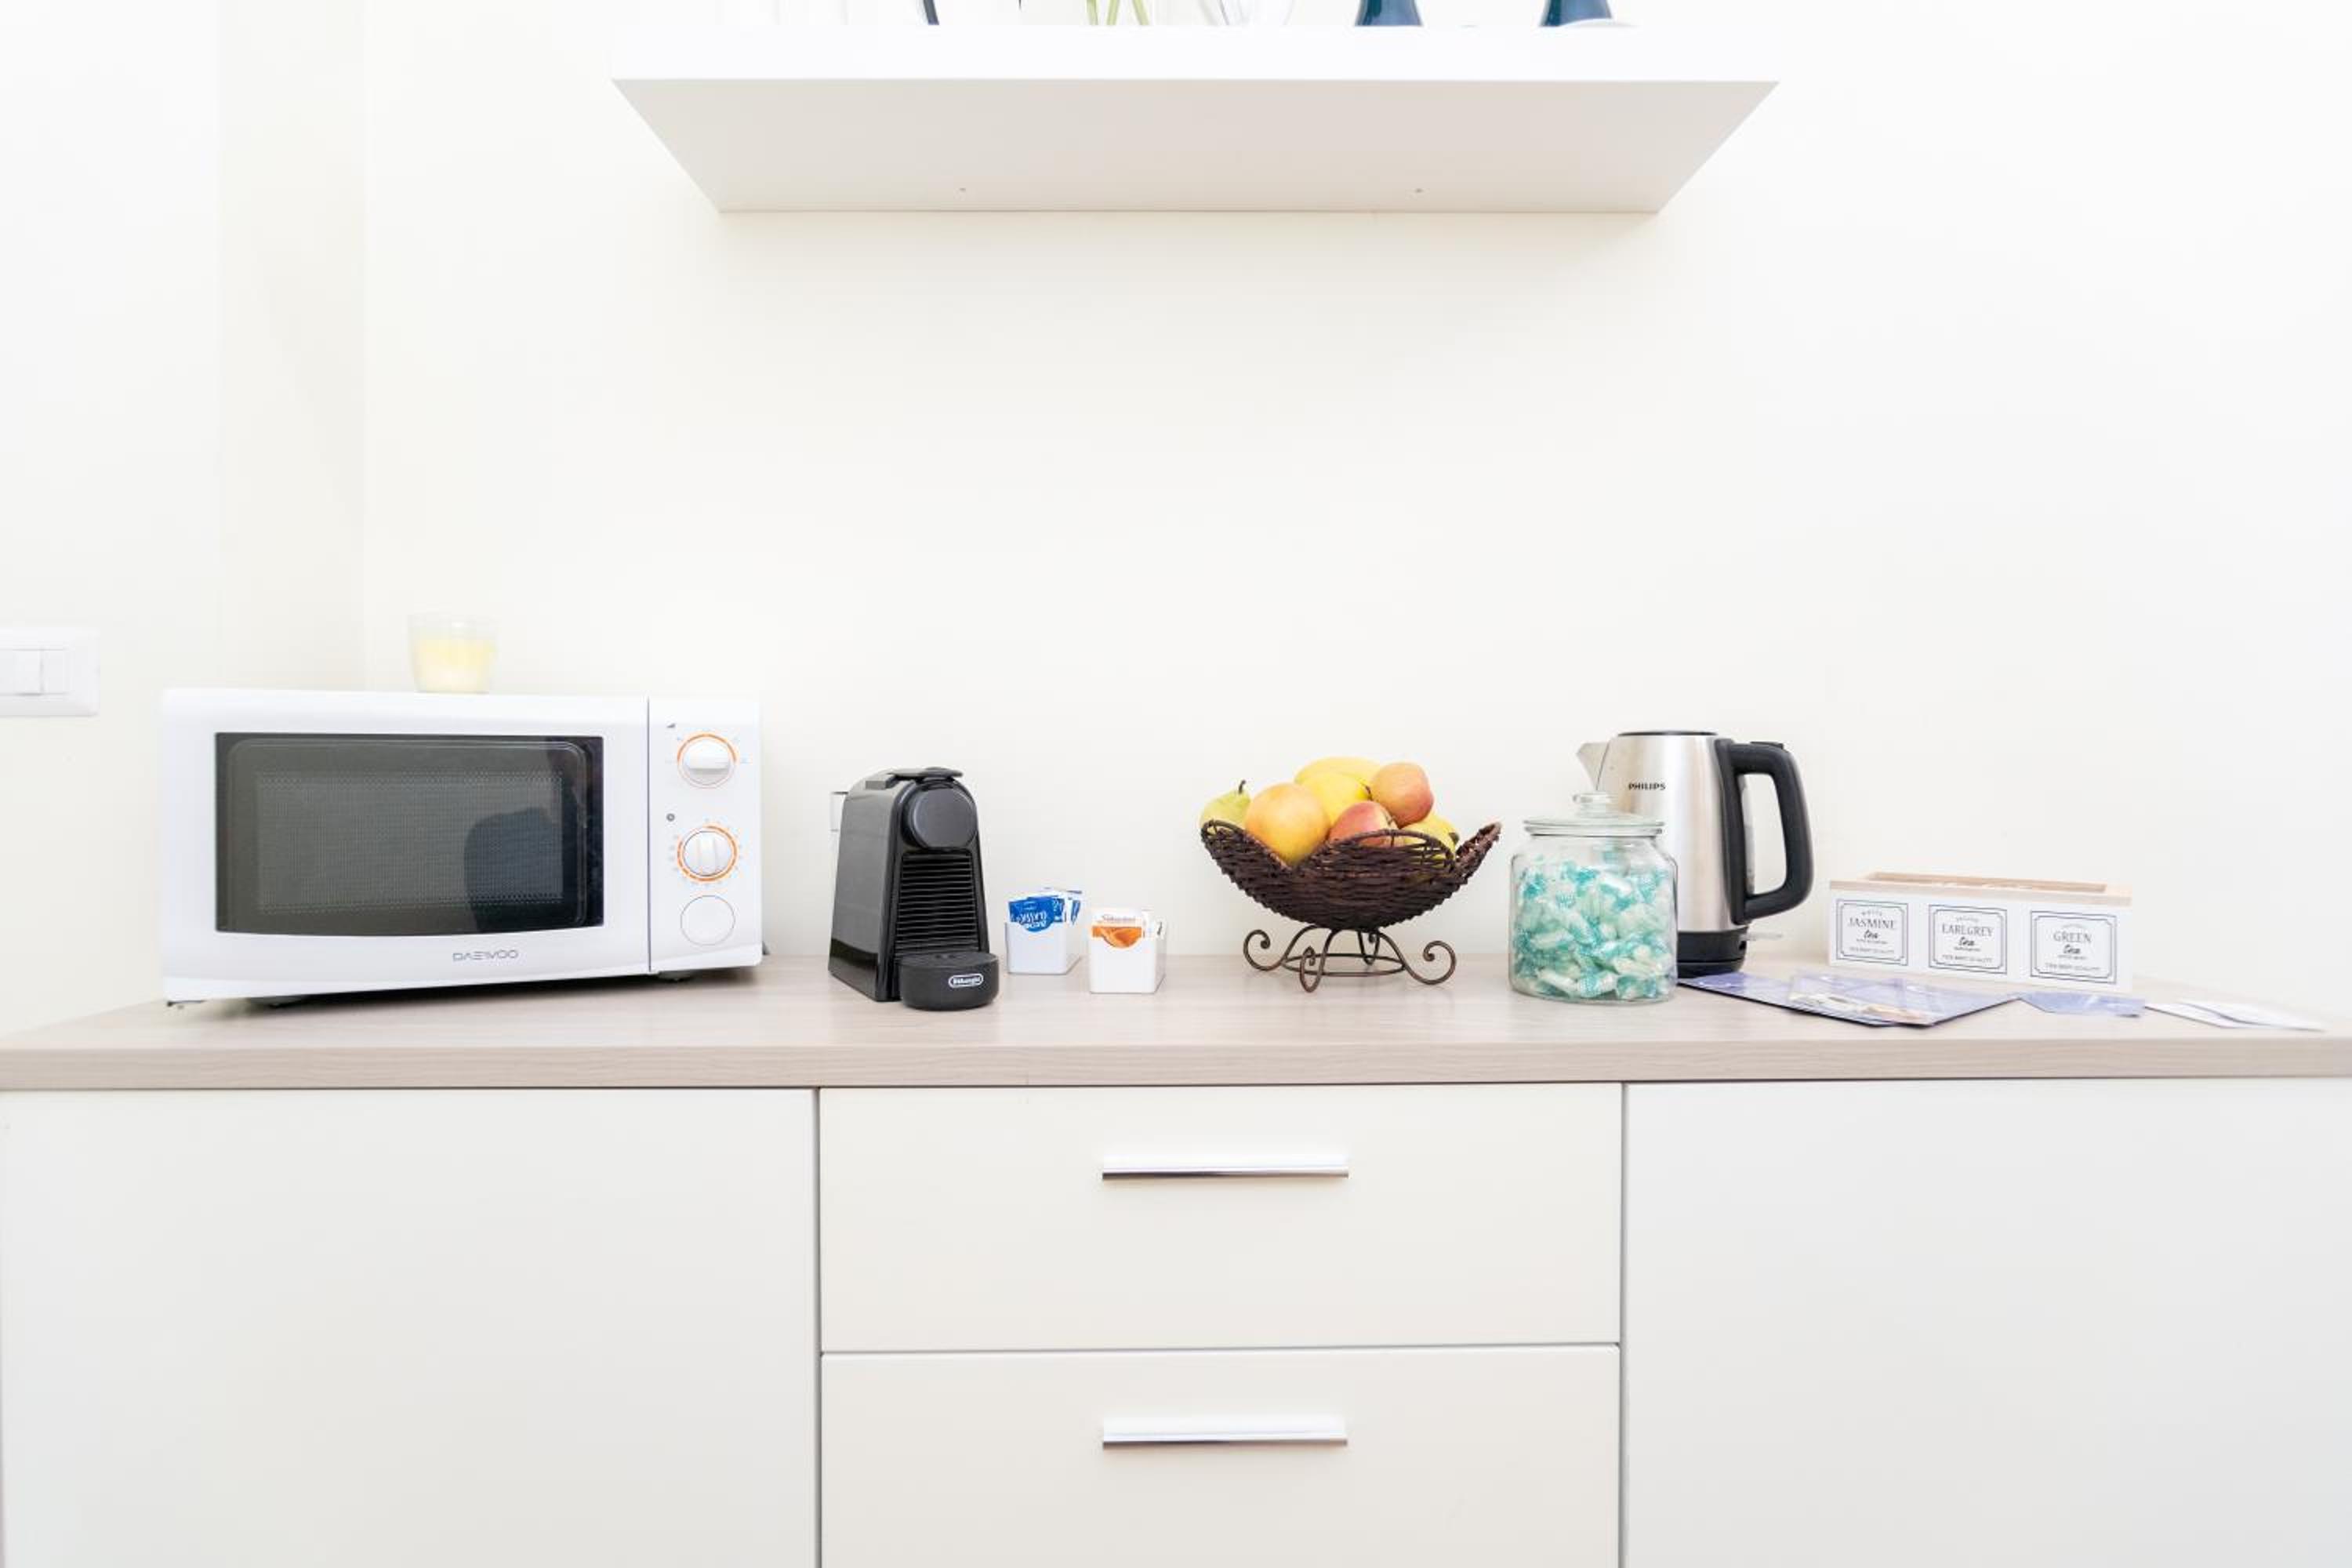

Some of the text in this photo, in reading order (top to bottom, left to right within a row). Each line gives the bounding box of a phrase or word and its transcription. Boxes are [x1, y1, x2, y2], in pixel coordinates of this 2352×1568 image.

[1847, 917, 1896, 930] JASMINE
[1864, 929, 1879, 939] tea
[1942, 924, 1993, 937] EARLGREY
[1958, 936, 1976, 946] tea
[2053, 931, 2092, 943] GREEN
[452, 949, 519, 961] DAEWOO
[2063, 944, 2082, 954] tea
